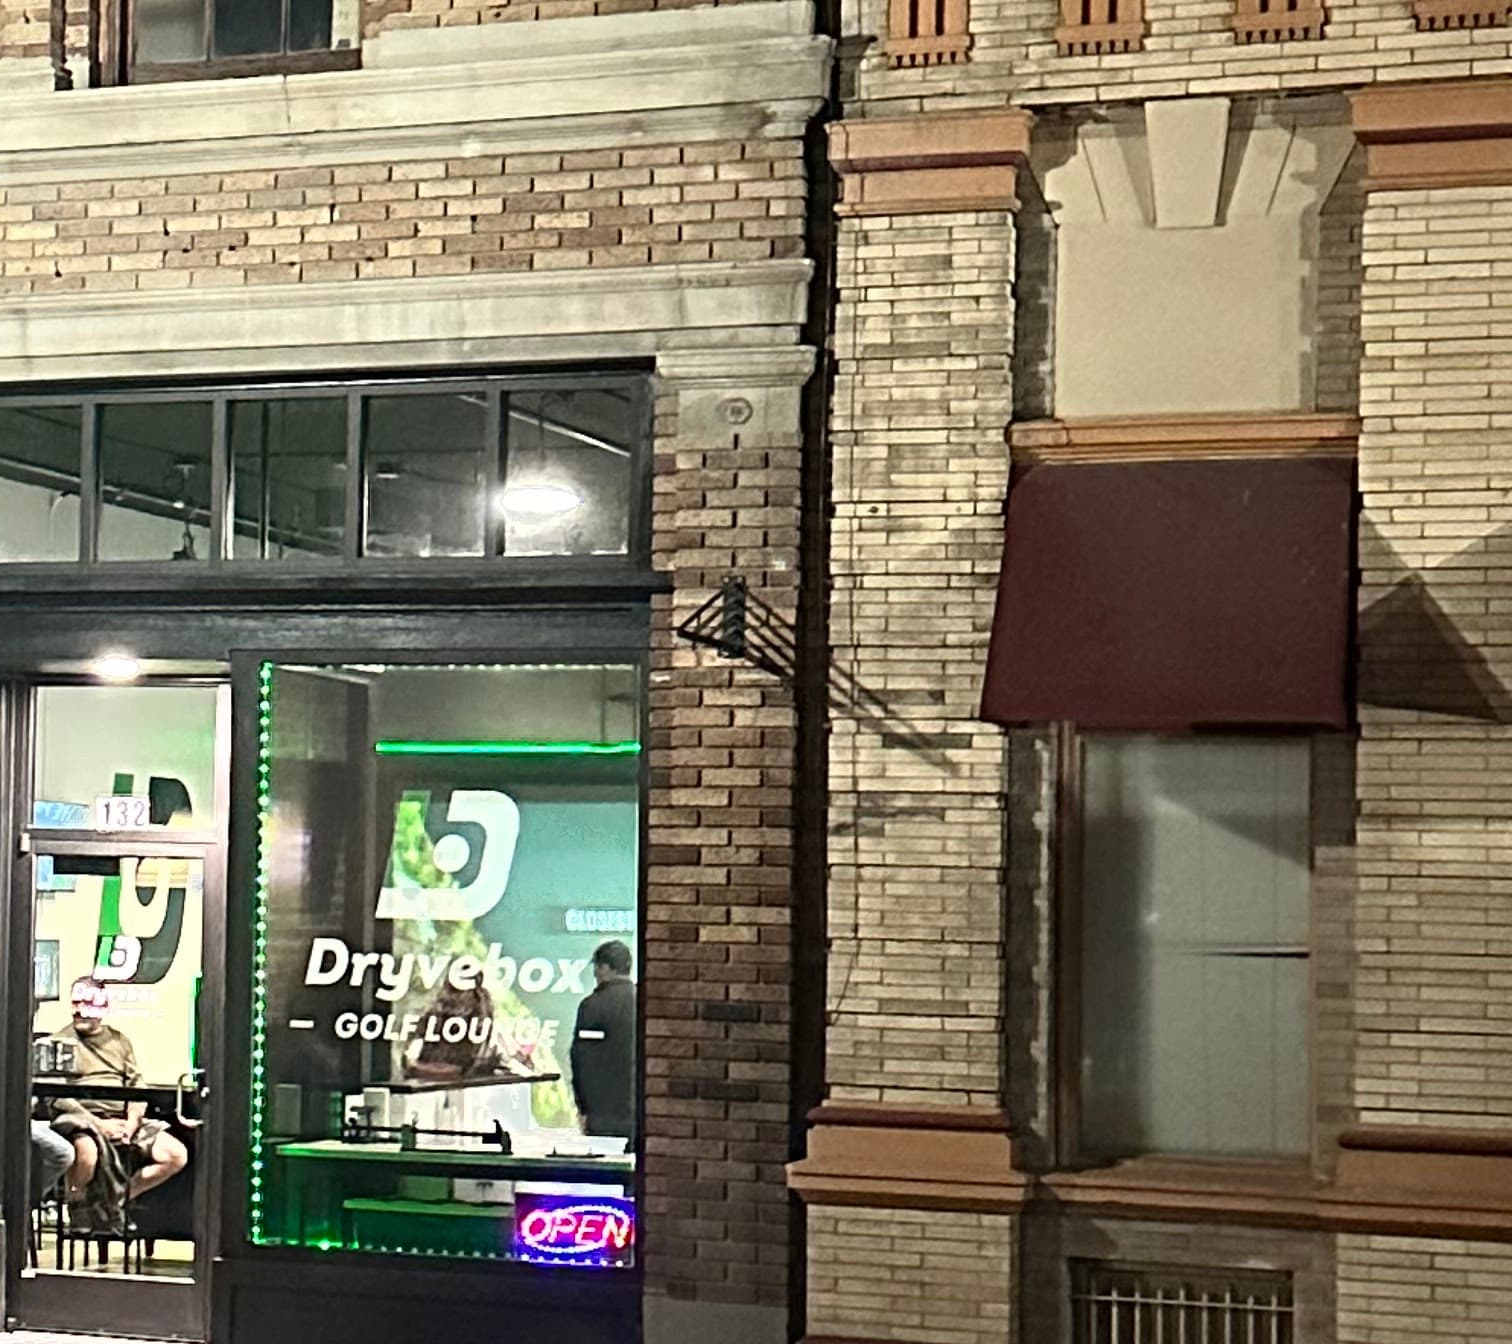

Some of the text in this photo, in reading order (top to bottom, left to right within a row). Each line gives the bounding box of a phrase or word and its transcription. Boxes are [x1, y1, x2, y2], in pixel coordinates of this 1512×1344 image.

[102, 801, 146, 827] 132
[304, 937, 586, 1001] Dryvebox
[335, 1012, 560, 1046] GOLF LOUNGE
[520, 1209, 630, 1248] OPEN
